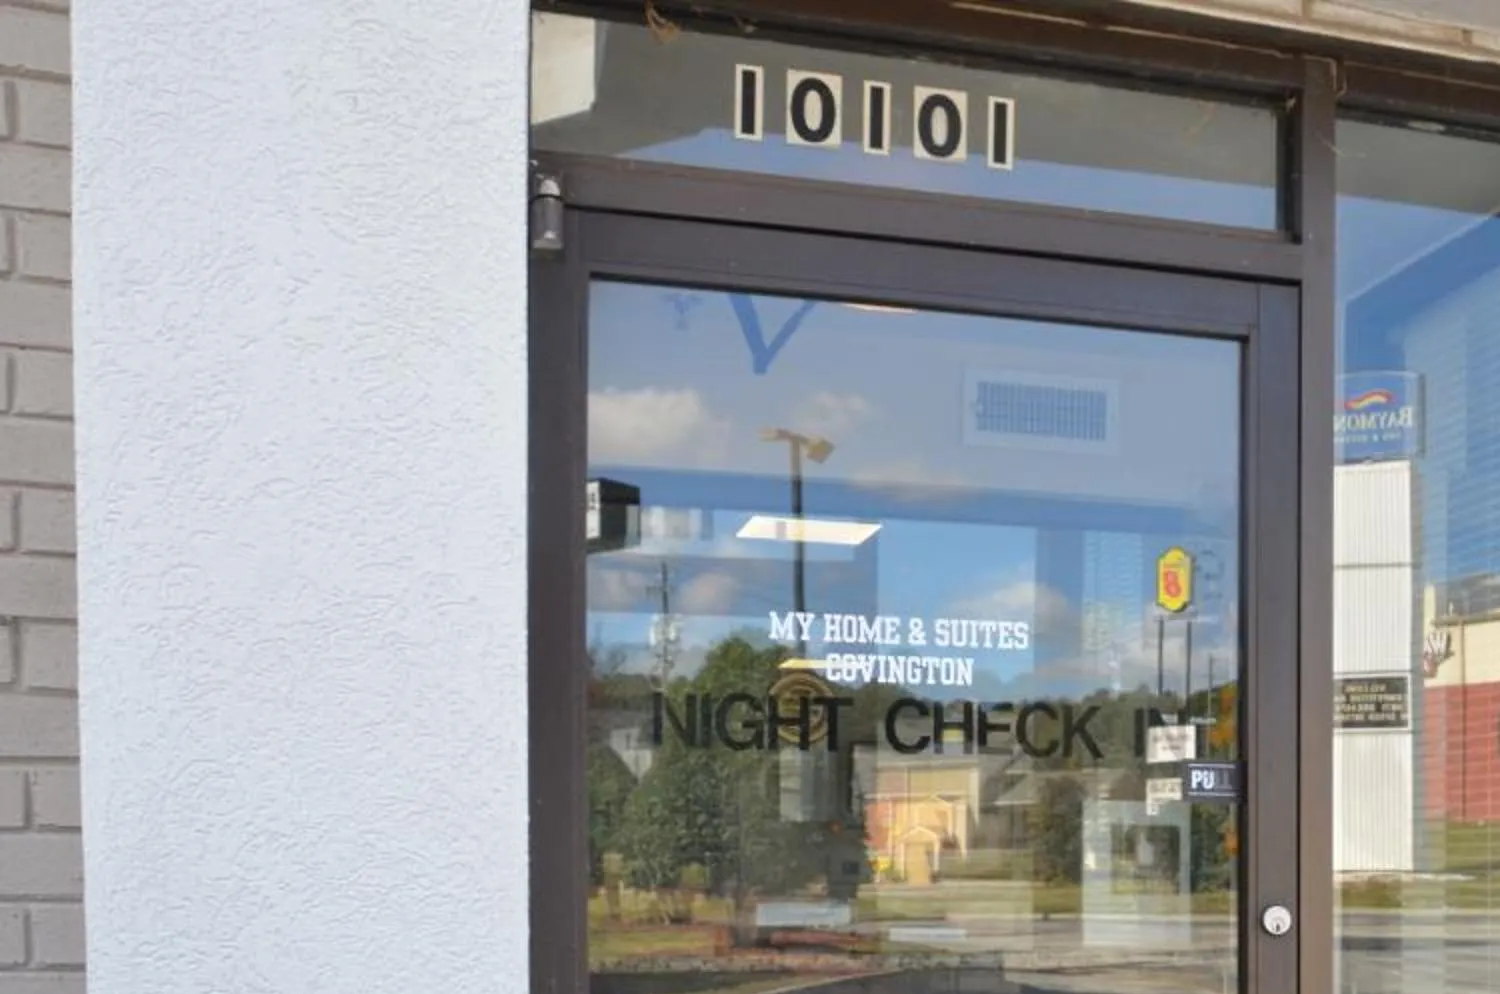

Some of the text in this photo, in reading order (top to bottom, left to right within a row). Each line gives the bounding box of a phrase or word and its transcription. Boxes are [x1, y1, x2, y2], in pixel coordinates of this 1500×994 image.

[738, 66, 1010, 168] 10101
[768, 611, 1030, 650] MY HOME & SUITES
[825, 652, 974, 686] COVINGTON
[651, 691, 854, 752] NIGHT
[884, 697, 1104, 759] CHECK
